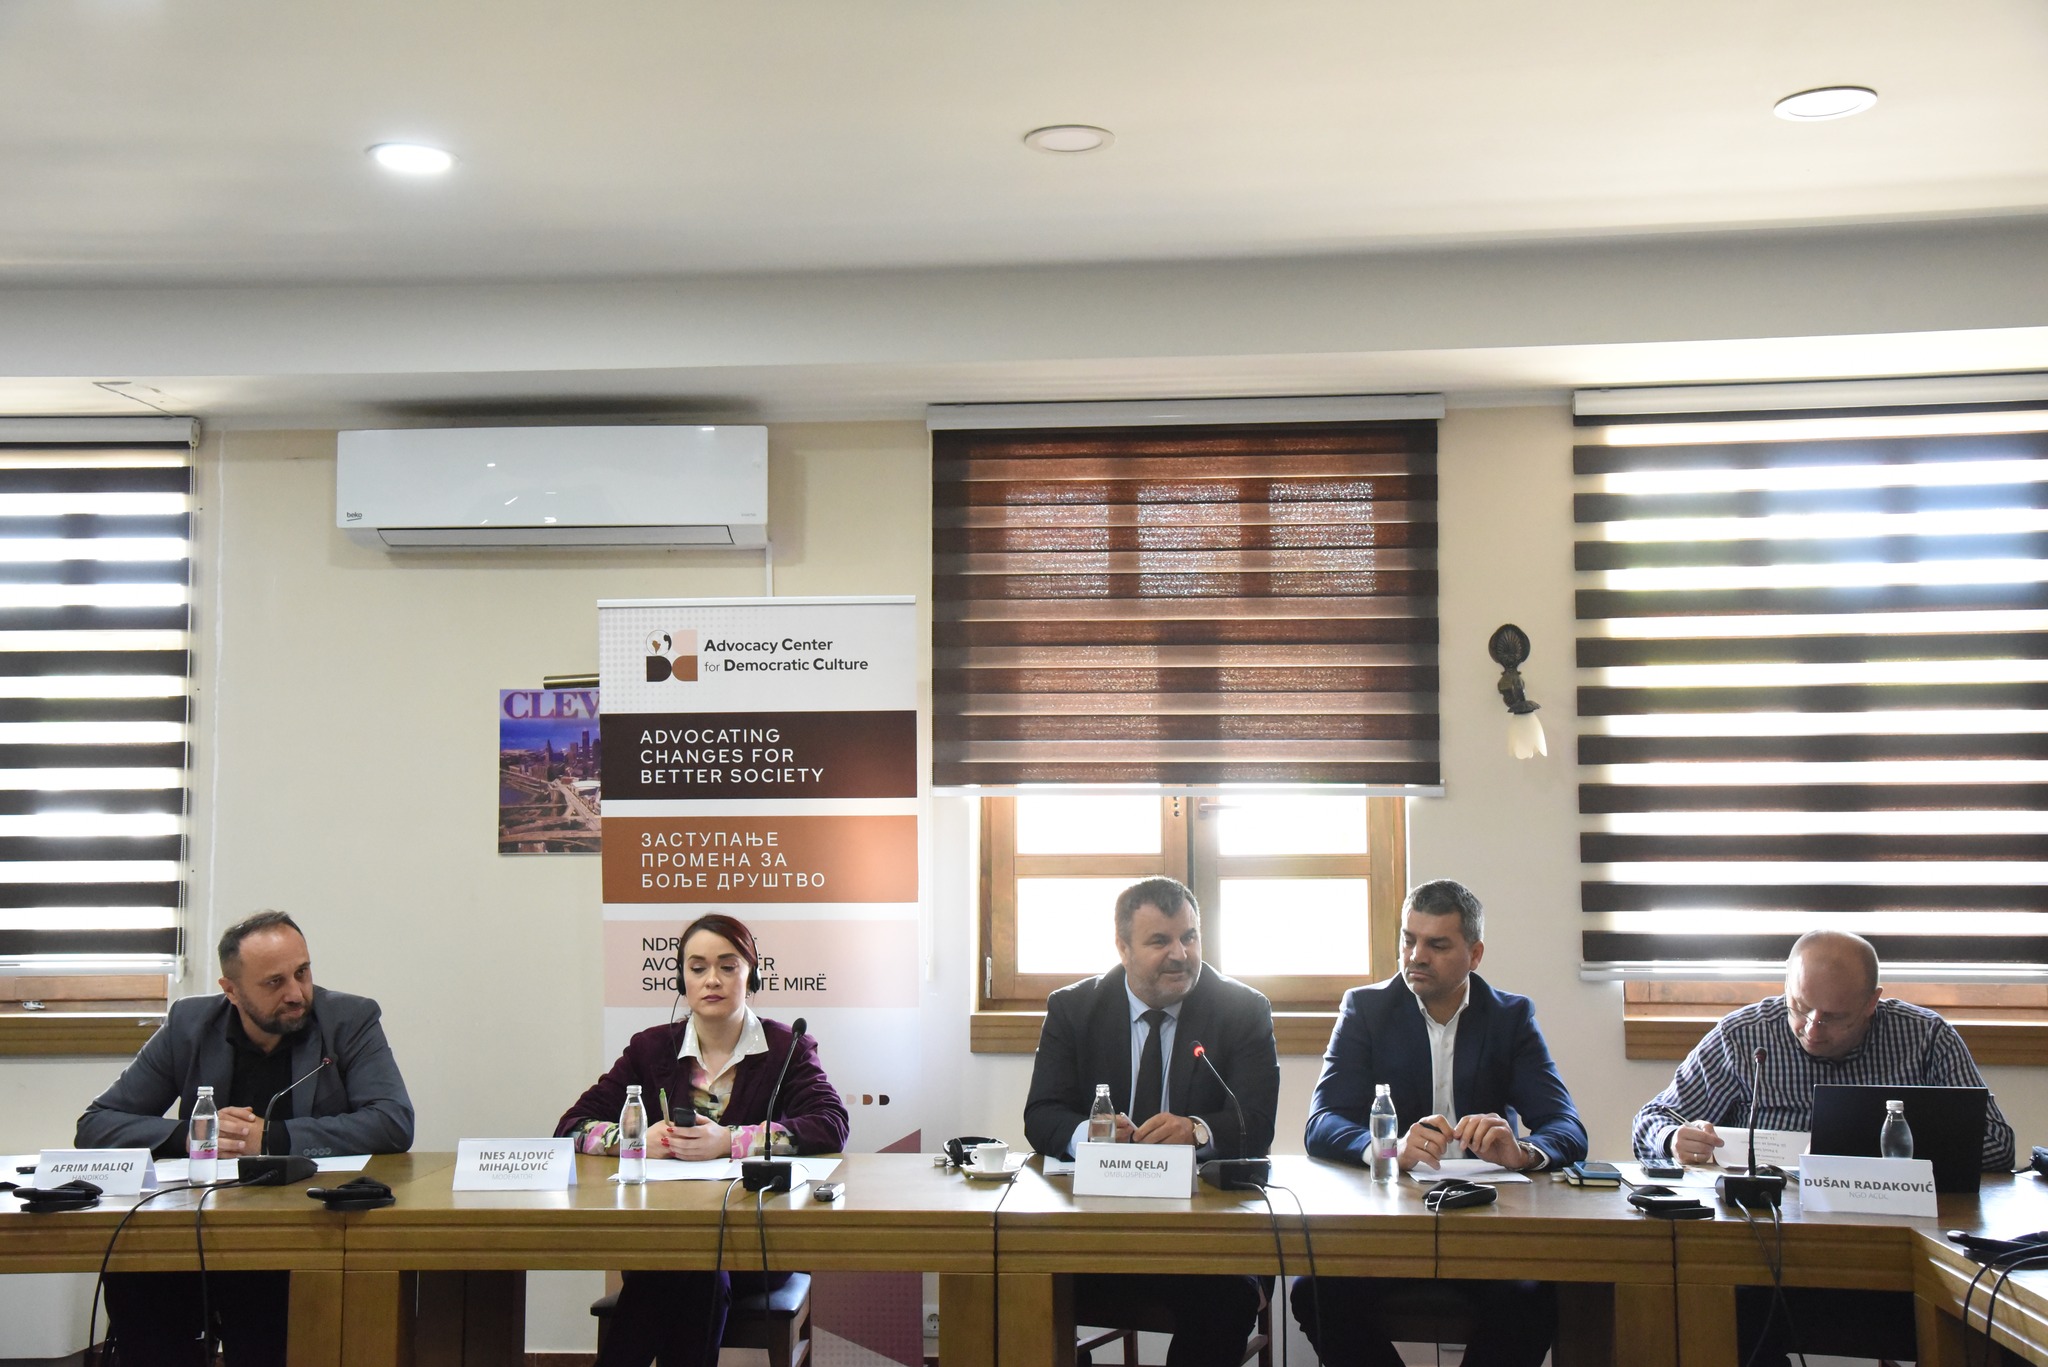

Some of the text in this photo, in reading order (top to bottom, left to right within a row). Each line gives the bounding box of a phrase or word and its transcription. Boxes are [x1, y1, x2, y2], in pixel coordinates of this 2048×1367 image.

[704, 638, 833, 654] Advocacy Center
[704, 657, 869, 672] for Democratic Culture
[503, 691, 600, 720] CLEV
[640, 728, 780, 744] ADVOCATING
[640, 748, 794, 764] CHANGES FOR
[641, 768, 824, 784] BETTER SOCIETY
[641, 832, 779, 847] ЗАСТУПАЊЕ
[641, 852, 788, 868] ПРОМЕНА ЗА
[642, 872, 825, 890] БОЉЕ ДРУШТВО
[784, 973, 827, 991] MIRË
[480, 1149, 555, 1162] INES ALJOVIĆ
[51, 1162, 134, 1173] AFRIM MALIQI
[479, 1161, 549, 1173] MIHAJLOVIĆ
[1099, 1159, 1169, 1172] NAIM QELAJ
[72, 1173, 109, 1181] HANDIKOS
[1104, 1171, 1162, 1179] OMBUDSPERSON
[1804, 1177, 1934, 1193] DUŠAN RADAKOVIĆ
[1849, 1191, 1867, 1199] NGO
